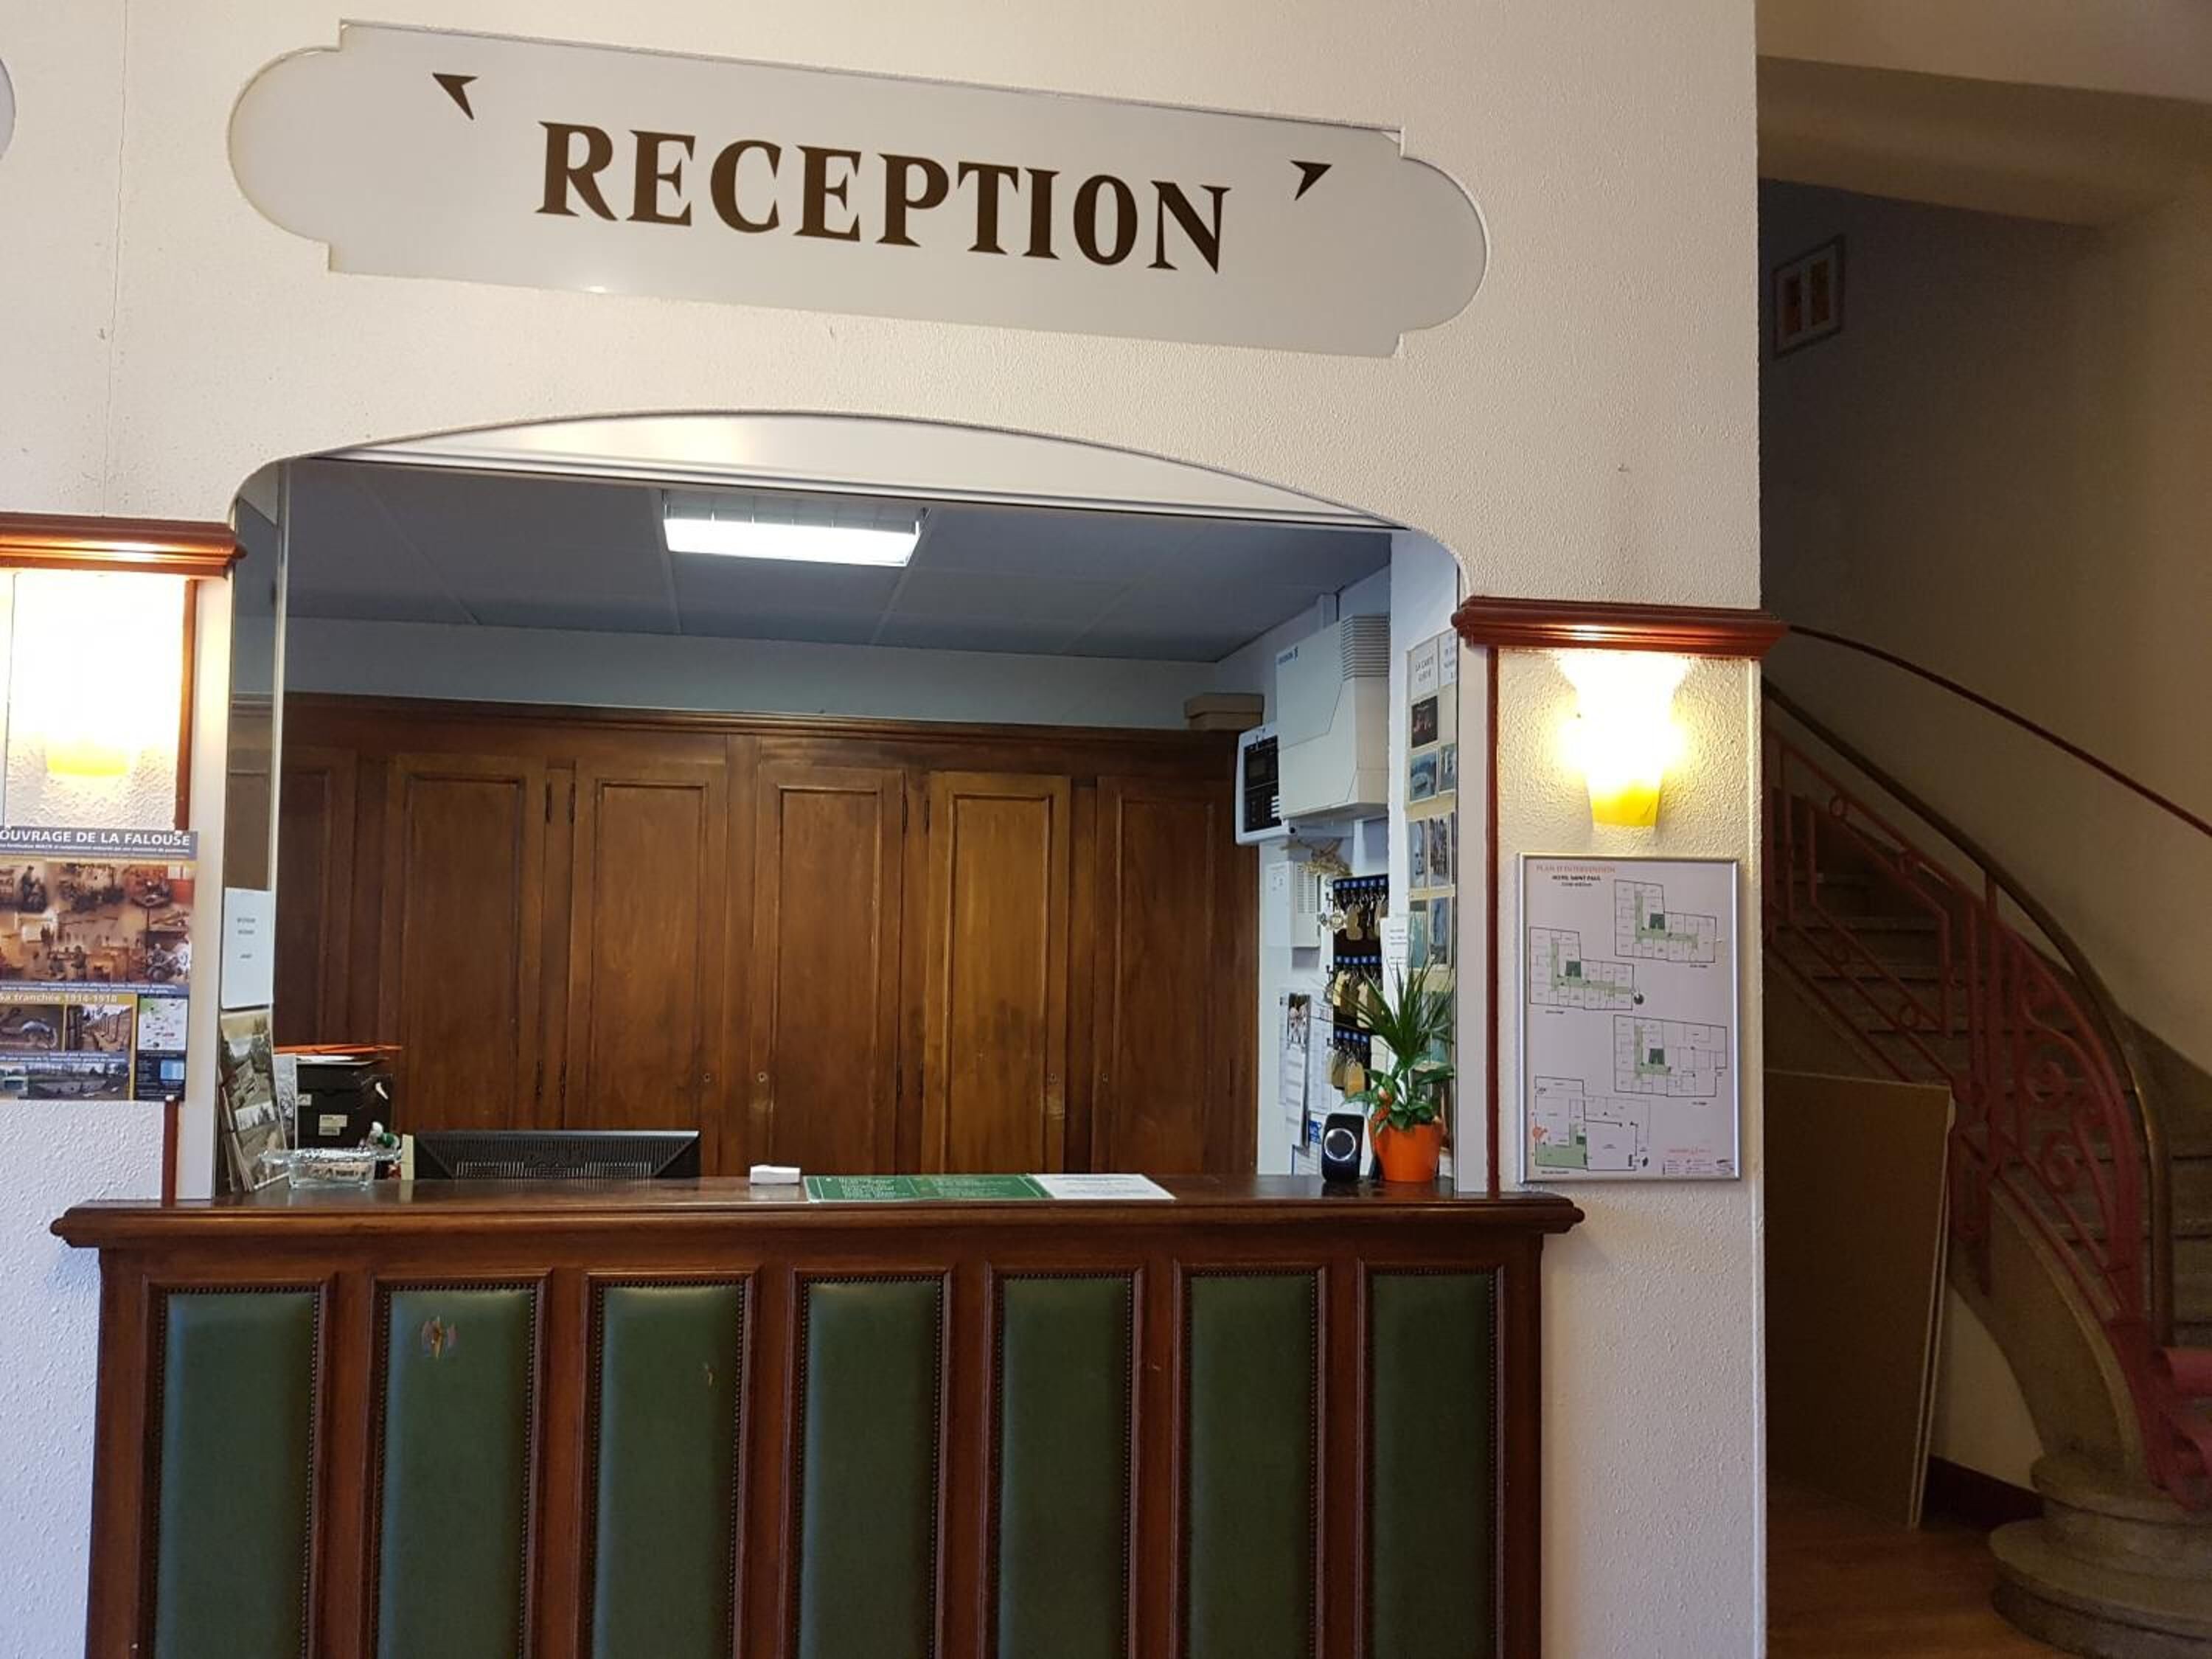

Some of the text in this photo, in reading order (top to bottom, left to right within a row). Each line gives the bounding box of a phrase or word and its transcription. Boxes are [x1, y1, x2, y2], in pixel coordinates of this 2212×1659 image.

[535, 121, 1232, 274] RECEPTION
[76, 832, 97, 843] DE
[100, 832, 119, 844] LA
[124, 833, 190, 846] FALOUSE
